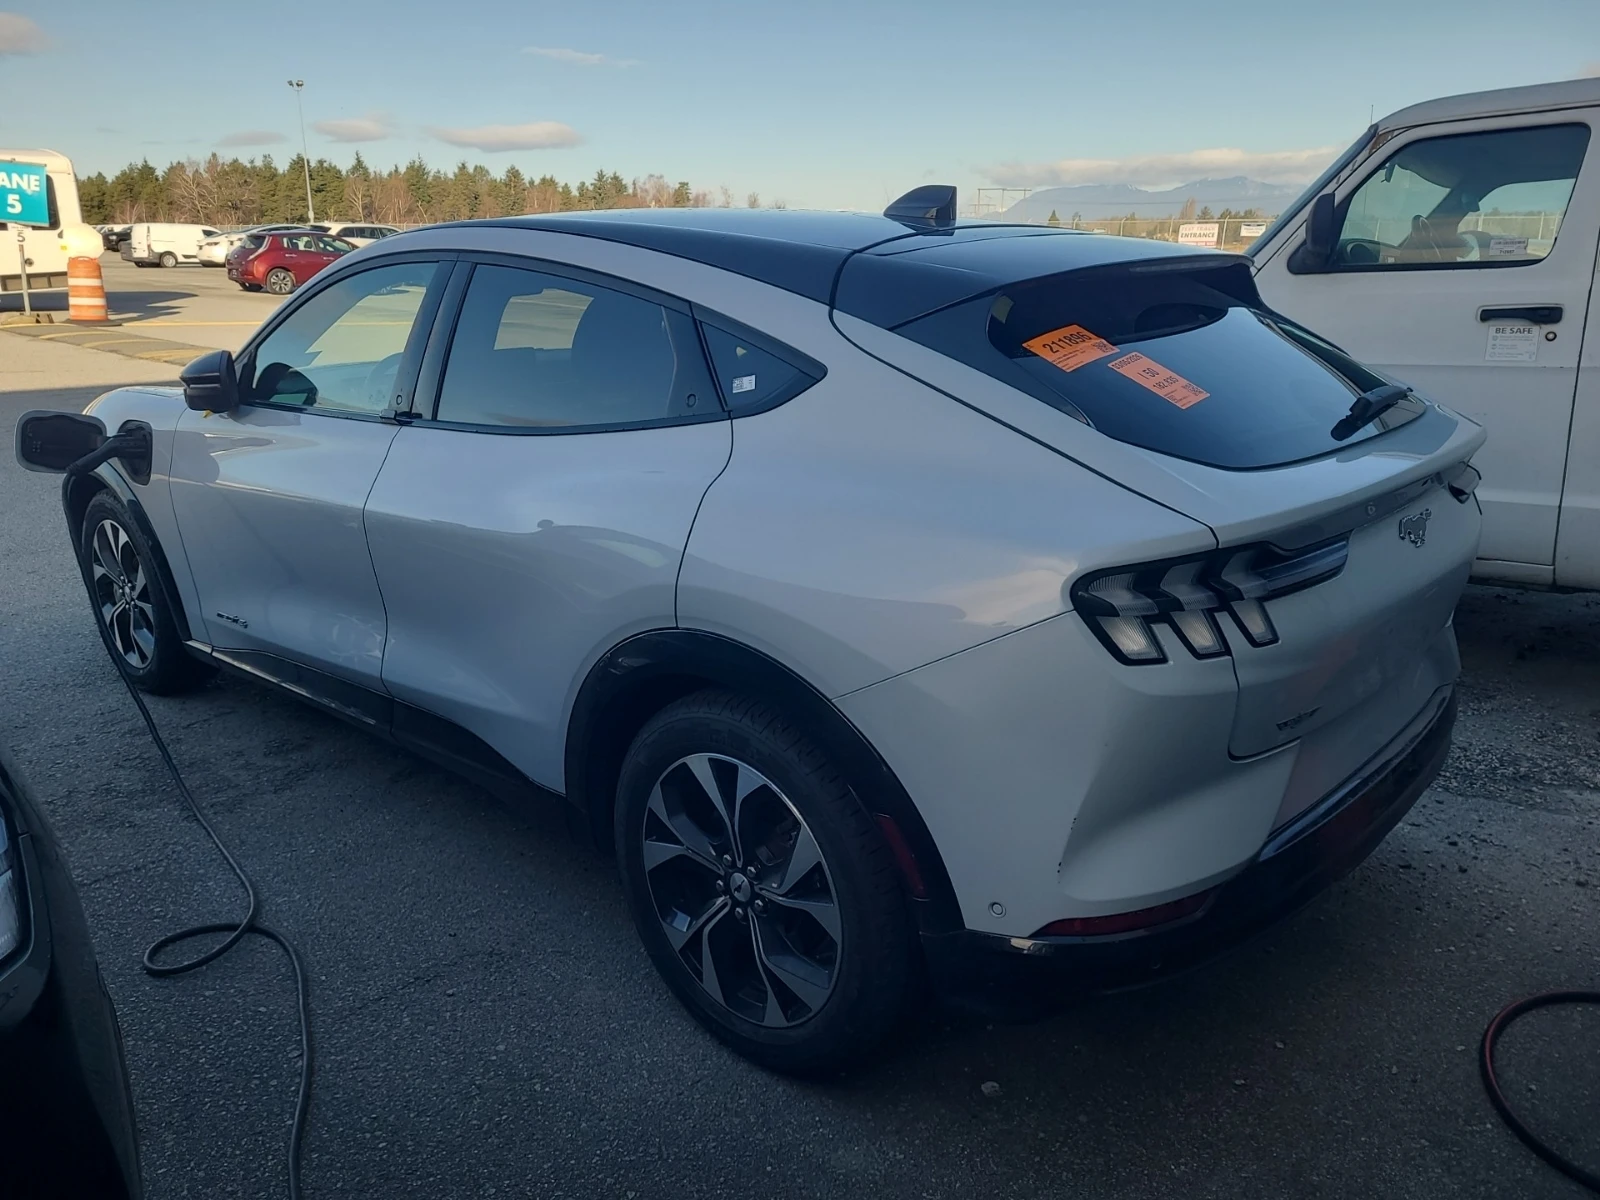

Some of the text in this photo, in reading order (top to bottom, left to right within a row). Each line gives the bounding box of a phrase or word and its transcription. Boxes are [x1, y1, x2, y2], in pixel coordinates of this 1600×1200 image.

[7, 193, 22, 214] 5
[17, 231, 26, 243] 5
[1042, 331, 1092, 354] 211896
